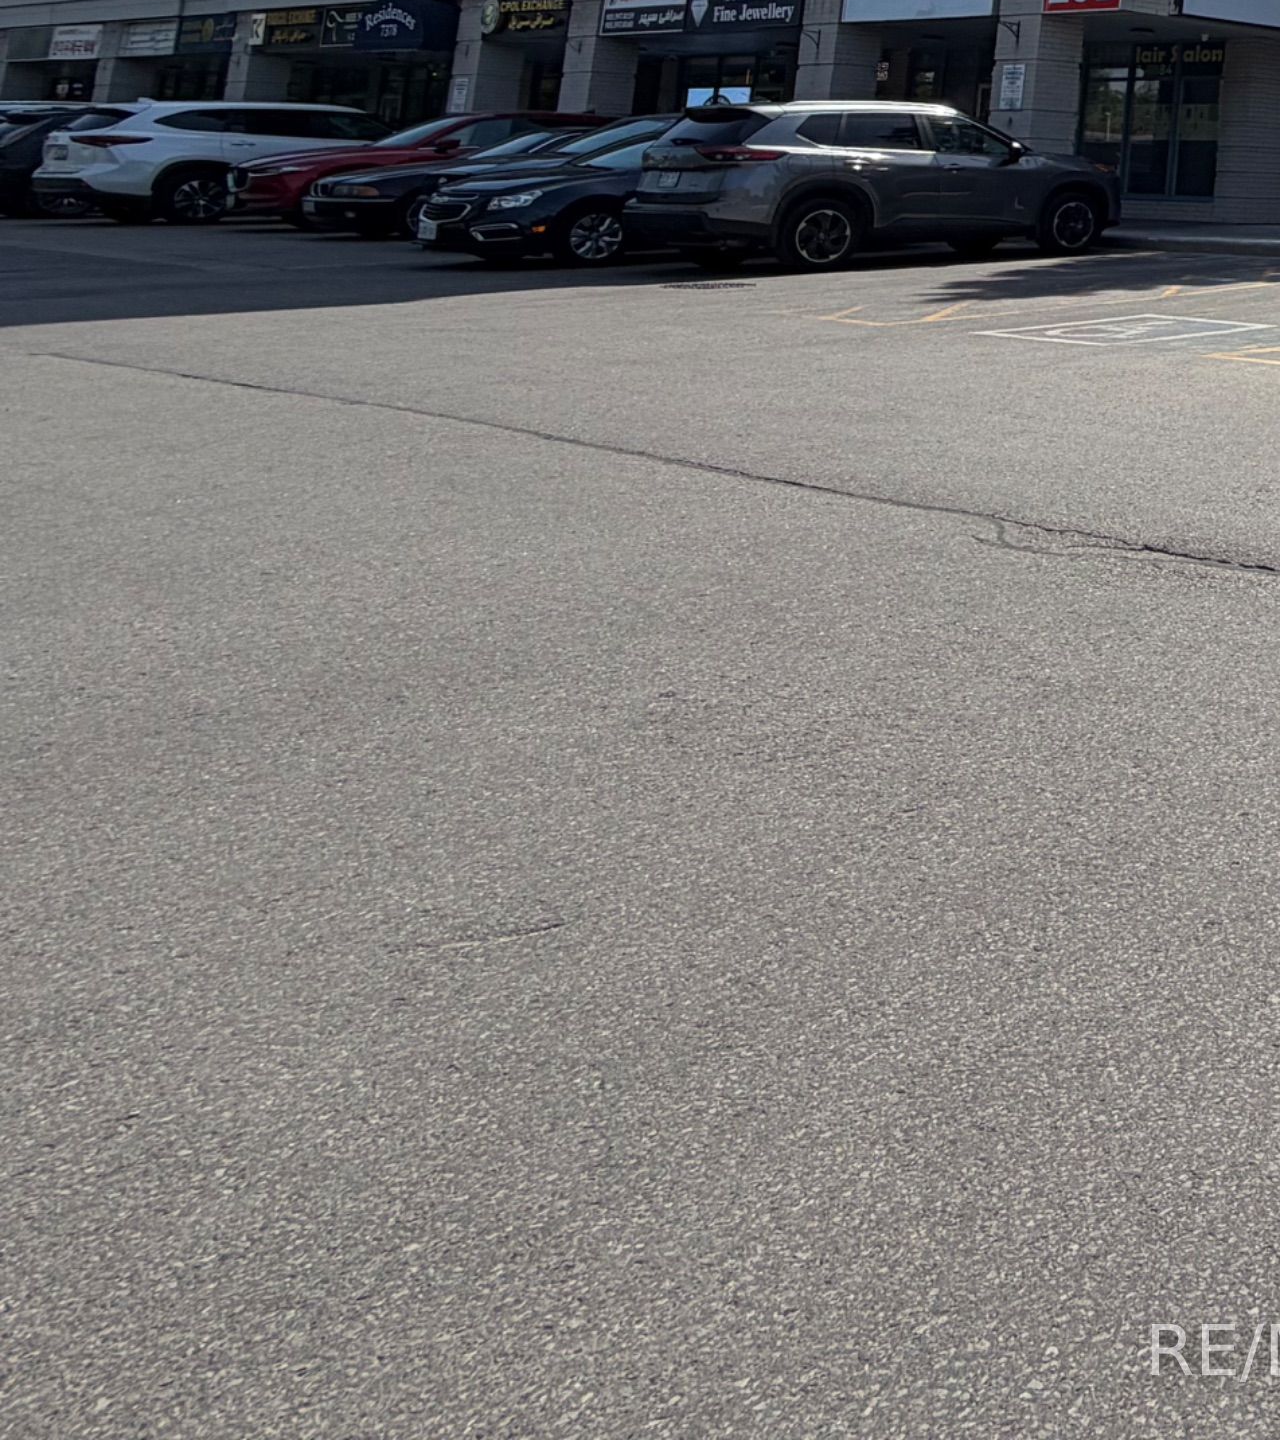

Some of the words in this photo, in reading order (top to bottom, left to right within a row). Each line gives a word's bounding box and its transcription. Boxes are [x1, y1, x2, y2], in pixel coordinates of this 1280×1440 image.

[364, 2, 417, 32] Residences
[712, 5, 738, 24] Fine
[739, 2, 795, 24] Jewellery
